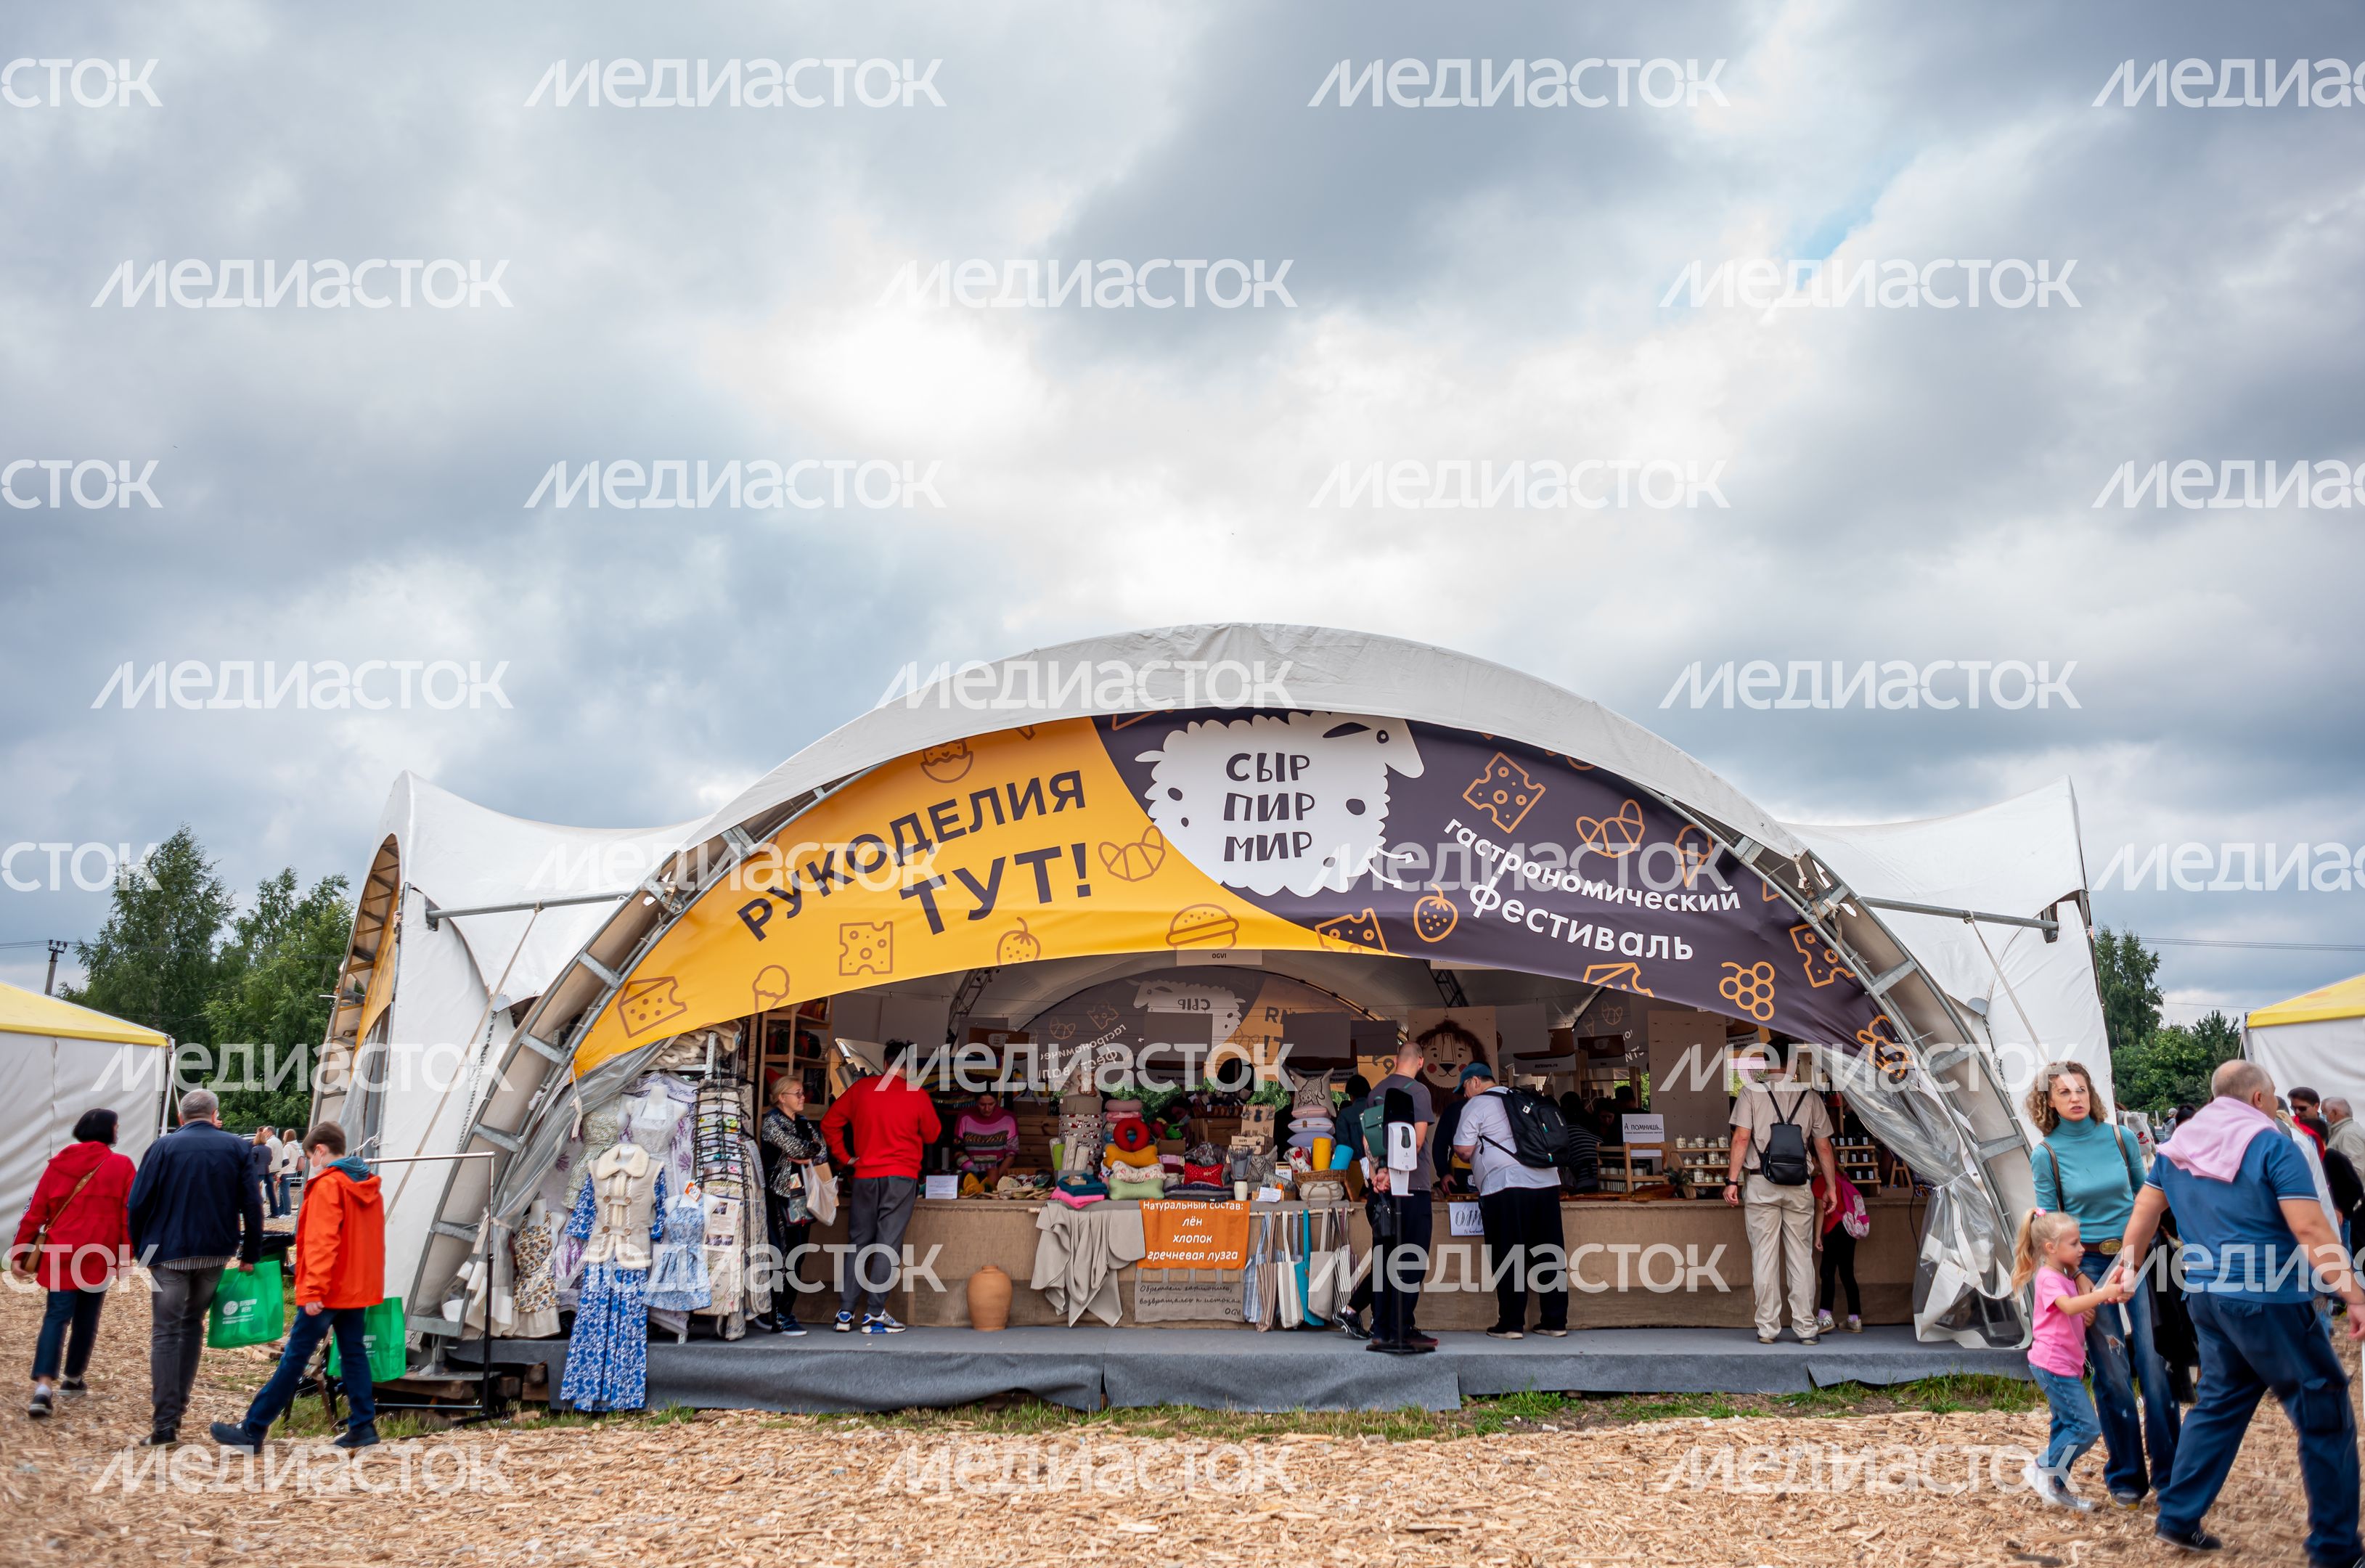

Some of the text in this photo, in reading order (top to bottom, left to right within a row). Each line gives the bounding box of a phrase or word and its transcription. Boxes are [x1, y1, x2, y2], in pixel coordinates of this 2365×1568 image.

[1225, 752, 1310, 783] СЫР
[1223, 792, 1315, 822] ПИР
[736, 769, 1086, 942] РУКОДЕЛИЯ
[1223, 831, 1313, 862] МИР
[1444, 818, 1741, 912] гастрономический
[899, 842, 1091, 935] ТУТ!
[1469, 875, 1694, 960] фестиваль
[1143, 1201, 1243, 1212] Натуральный состав:
[1182, 1216, 1203, 1227] лён
[1172, 1234, 1213, 1244] хлопок
[1147, 1250, 1238, 1262] гречневая лузга
